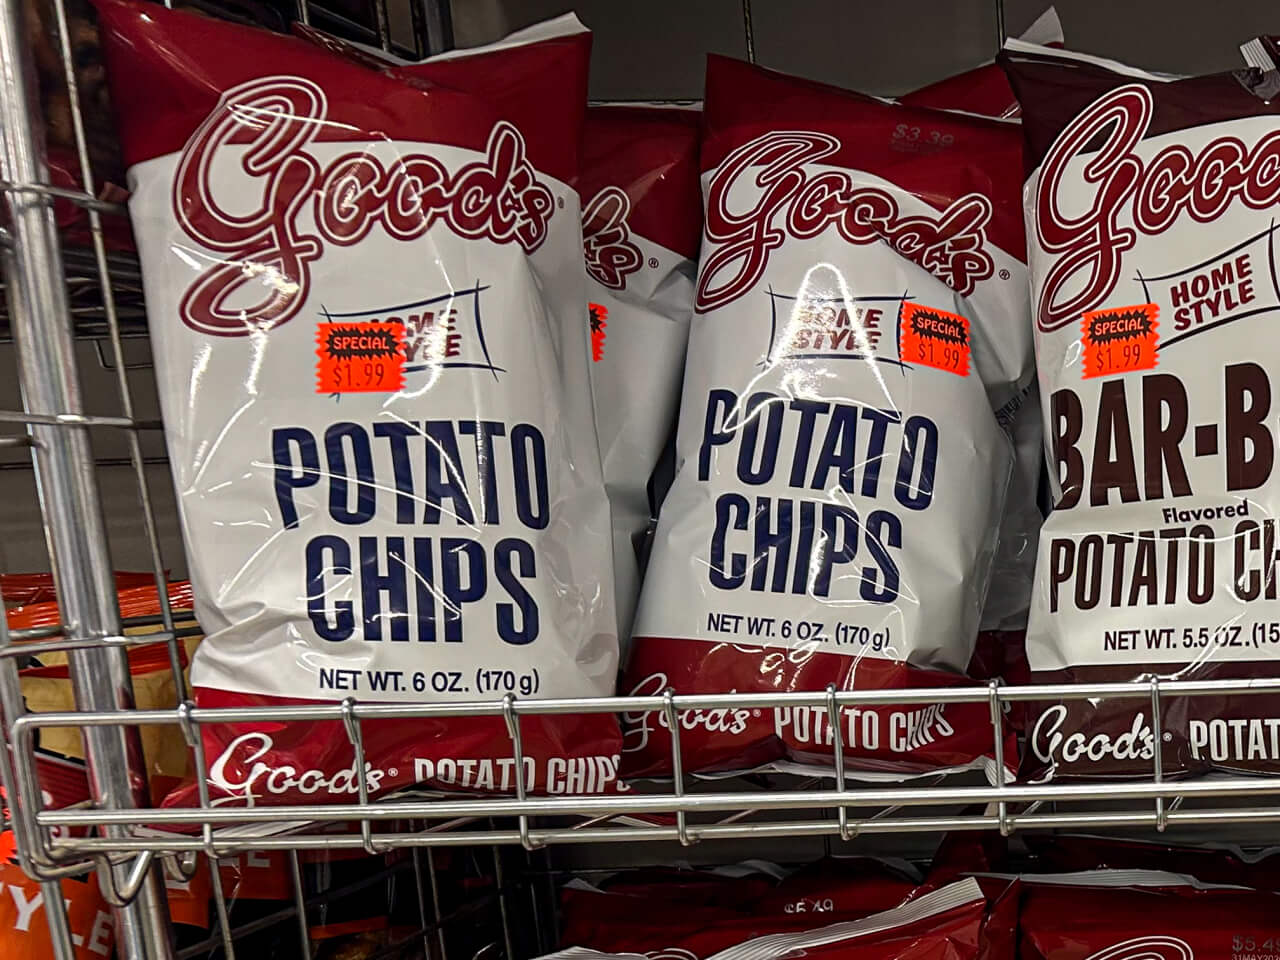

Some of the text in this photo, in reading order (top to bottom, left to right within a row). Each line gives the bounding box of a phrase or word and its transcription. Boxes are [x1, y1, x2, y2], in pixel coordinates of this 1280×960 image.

[1170, 253, 1254, 308] HOME
[1173, 279, 1257, 332] STYLE
[916, 315, 962, 339] SPECIAL
[1094, 317, 1144, 337] SPECIAL
[333, 336, 390, 351] SPECIAL
[918, 342, 960, 370] $1.99
[1096, 343, 1141, 372] $1.99
[333, 362, 385, 388] $1.99
[697, 388, 939, 512] POTATO
[270, 420, 551, 531] POTATO
[1162, 499, 1250, 525] Flavored
[708, 492, 903, 605] CHIPS
[1049, 523, 1222, 613] POTATO
[305, 535, 541, 646] CHIPS
[707, 612, 743, 635] NET
[746, 615, 779, 637] WT.
[781, 618, 793, 638] 6
[796, 619, 829, 642] OZ.
[1103, 628, 1142, 652] NET
[1145, 627, 1179, 651] WT.
[1182, 626, 1209, 650] 5.5
[1213, 624, 1249, 649] OZ.
[319, 669, 360, 691] NET
[367, 671, 407, 692] WT.
[413, 671, 425, 692] 6
[431, 671, 470, 693] OZ.
[889, 703, 955, 752] CHIPS
[414, 755, 536, 793] POTATO
